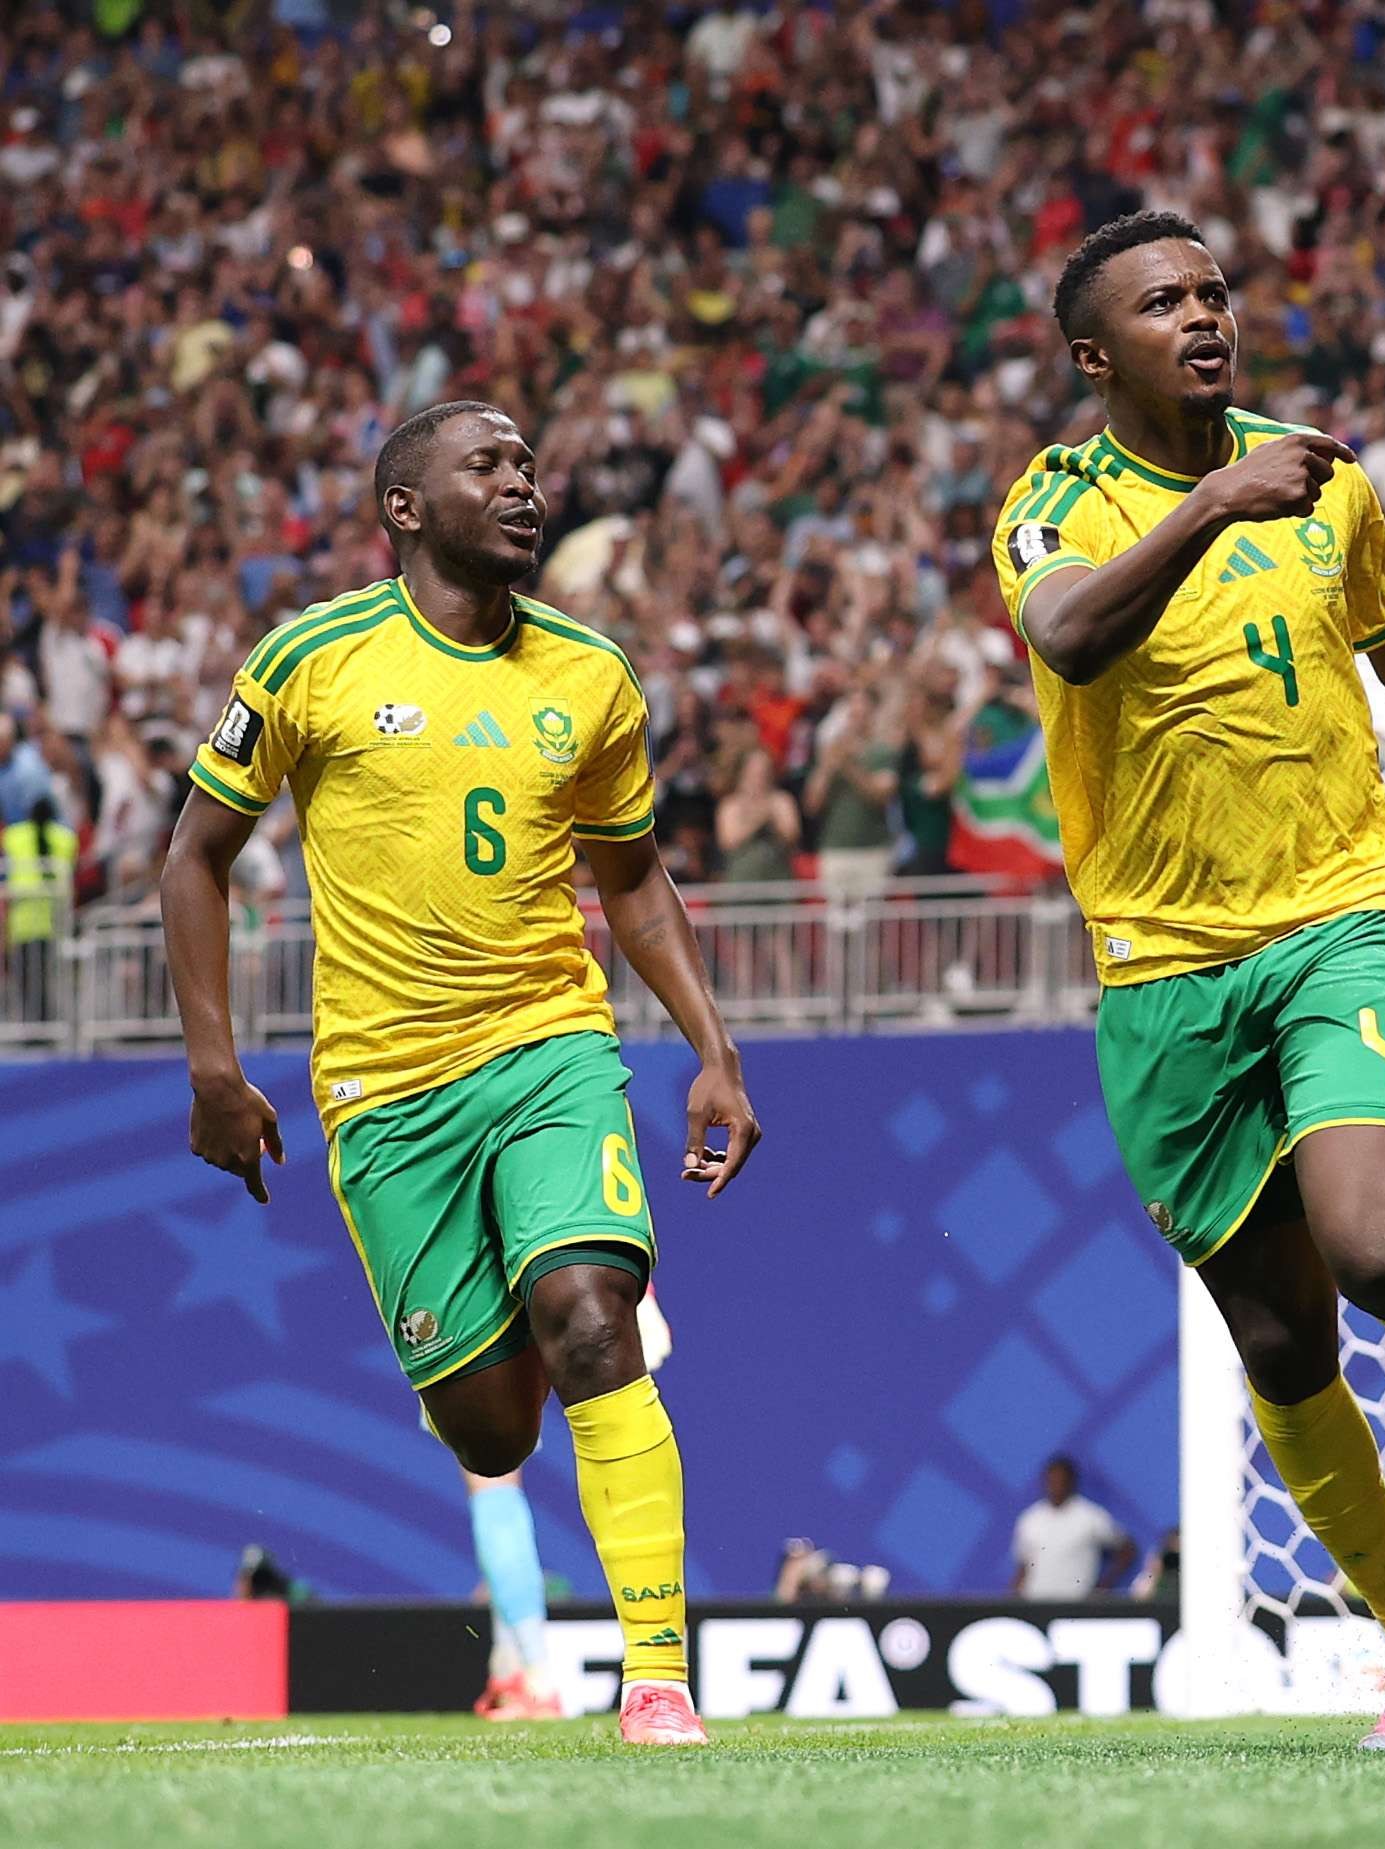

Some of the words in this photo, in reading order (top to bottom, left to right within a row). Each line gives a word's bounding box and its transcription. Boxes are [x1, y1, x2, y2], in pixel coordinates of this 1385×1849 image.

[1243, 614, 1300, 707] 4
[464, 786, 507, 876] 6
[601, 1132, 643, 1217] 6
[621, 1581, 683, 1603] SAFA
[544, 1616, 901, 1719] FFA
